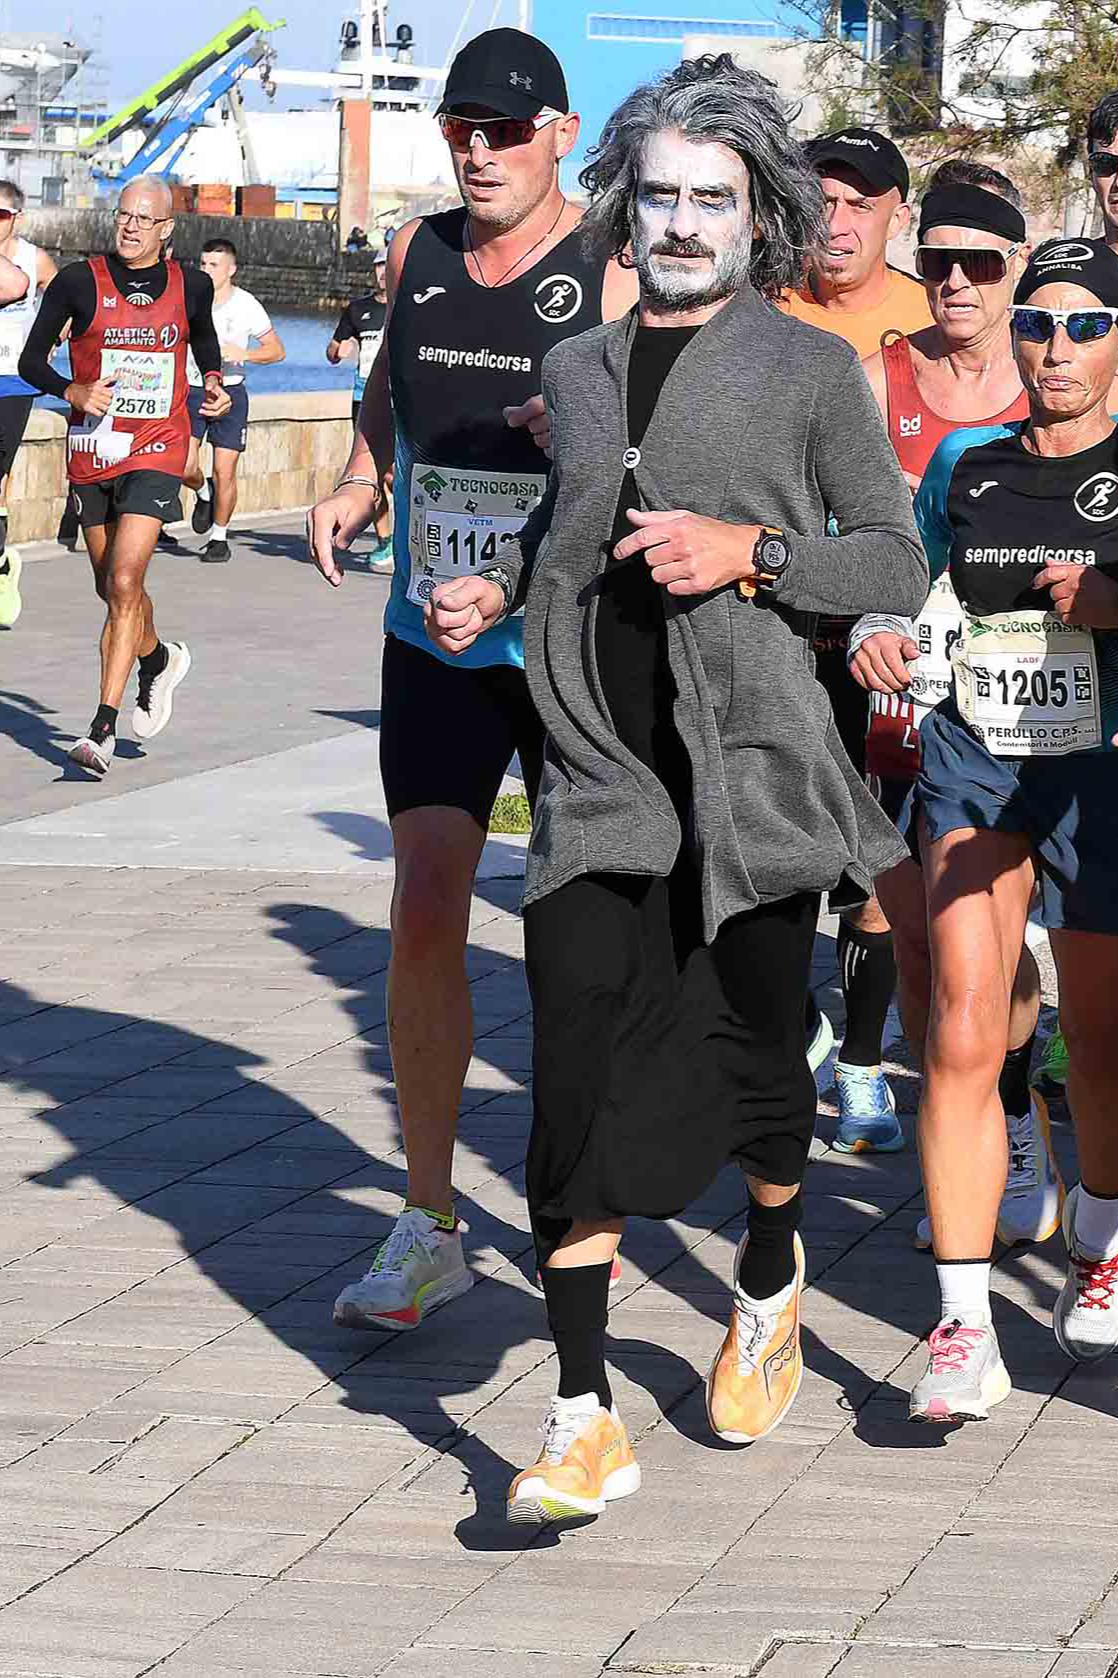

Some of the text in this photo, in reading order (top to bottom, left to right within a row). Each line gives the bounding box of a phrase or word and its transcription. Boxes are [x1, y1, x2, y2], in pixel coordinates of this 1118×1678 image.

[1036, 263, 1083, 276] ANNALISA
[104, 328, 155, 337] ATLETICA
[104, 337, 156, 346] AMARANTO
[418, 345, 532, 373] sempredicorsa
[116, 397, 156, 414] 2578
[450, 478, 539, 497] TECNOCASA
[1091, 507, 1106, 516] SDC
[468, 518, 493, 527] VETM
[964, 545, 1095, 567] sempredicorsa
[997, 669, 1069, 708] 1205
[988, 727, 1048, 739] PERULLO
[1050, 725, 1082, 738] C.P.S.
